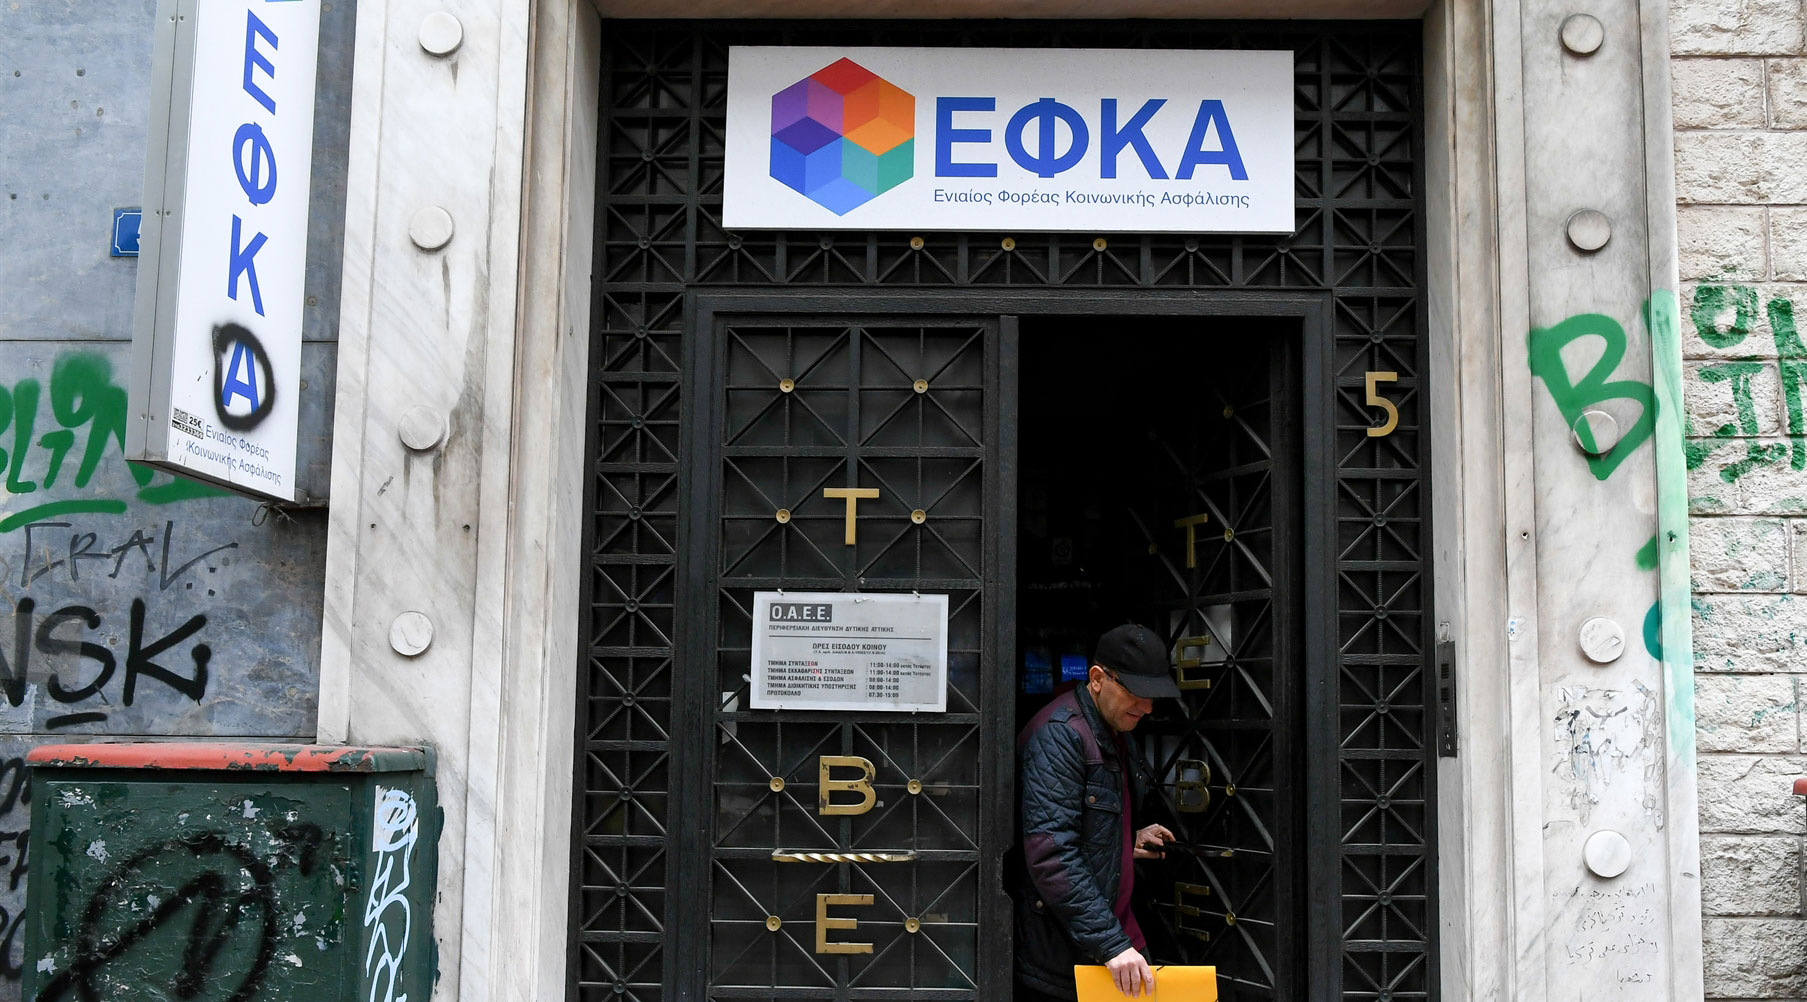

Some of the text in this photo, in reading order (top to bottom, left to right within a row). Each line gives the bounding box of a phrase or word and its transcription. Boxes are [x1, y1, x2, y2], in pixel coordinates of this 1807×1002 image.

[935, 97, 1249, 180] ΕΦΚΑ
[223, 9, 278, 414] ΕΦΚΑ
[934, 189, 1250, 208] Ενιαίος Φορέας Κοινωνικής Ασφάλισης
[1366, 372, 1398, 437] 5
[188, 440, 282, 486] Κοινωνικής Ασφάλισης
[205, 425, 270, 461] Ενιαίος Φορέας
[772, 606, 830, 620] Ο.Α.Ε.Ε.
